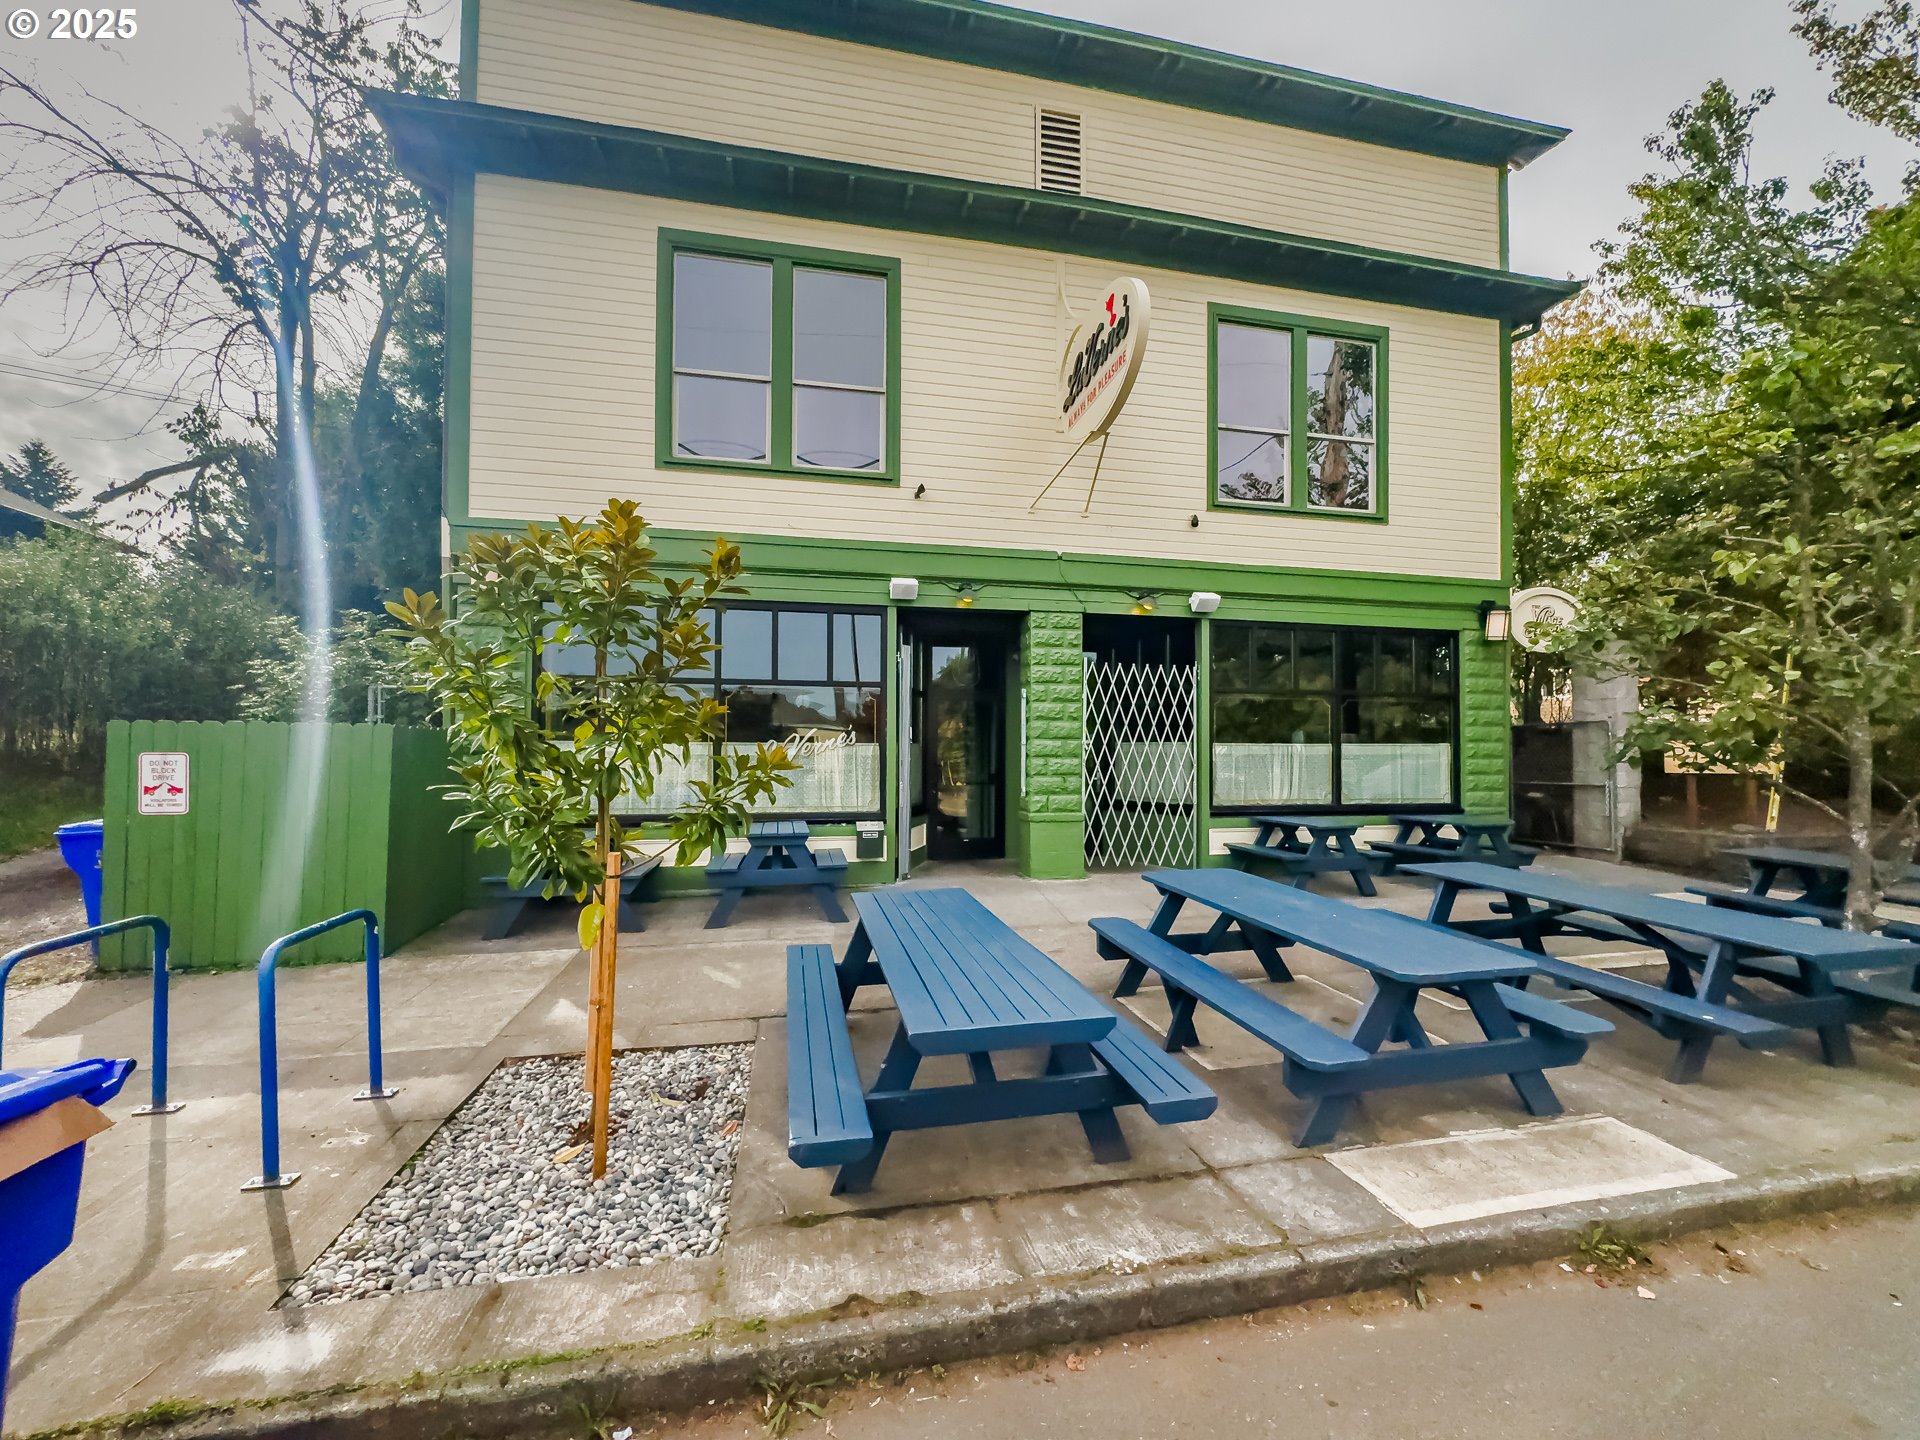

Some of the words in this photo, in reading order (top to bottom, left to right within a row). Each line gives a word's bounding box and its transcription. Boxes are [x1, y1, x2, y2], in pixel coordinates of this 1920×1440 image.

[1063, 294, 1130, 413] LaVerne's
[1068, 401, 1086, 428] ALWAYS
[1087, 388, 1097, 403] FOR
[1098, 350, 1127, 391] PLEASURE
[766, 724, 857, 762] Verne's
